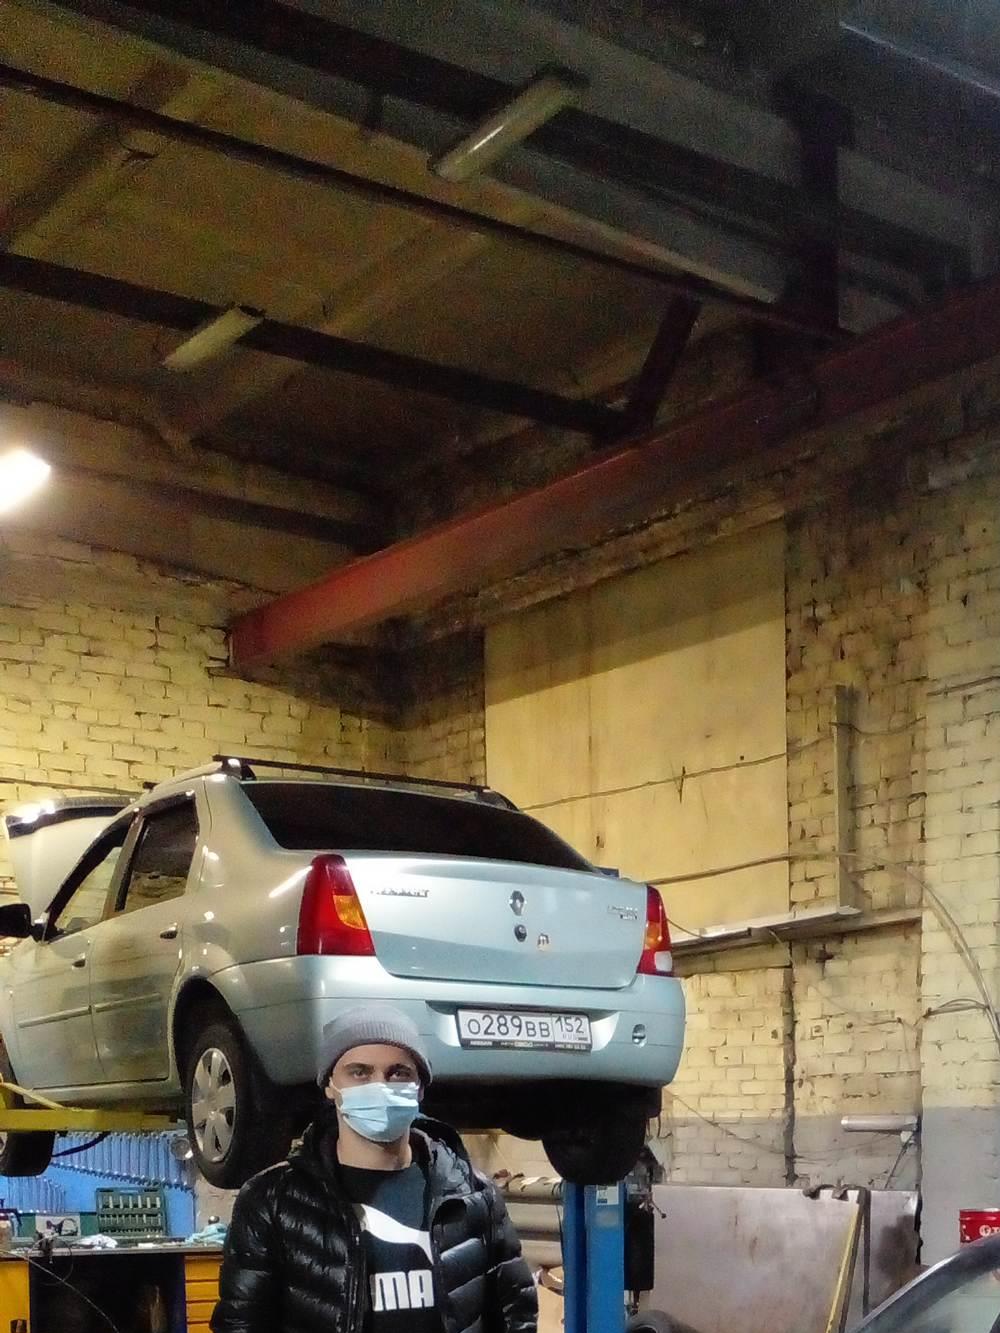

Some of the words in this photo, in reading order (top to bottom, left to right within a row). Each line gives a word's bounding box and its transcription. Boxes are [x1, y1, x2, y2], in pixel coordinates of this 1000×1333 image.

[467, 1014, 551, 1038] О289ВВ
[555, 1016, 585, 1034] 152
[370, 1270, 434, 1311] MA
